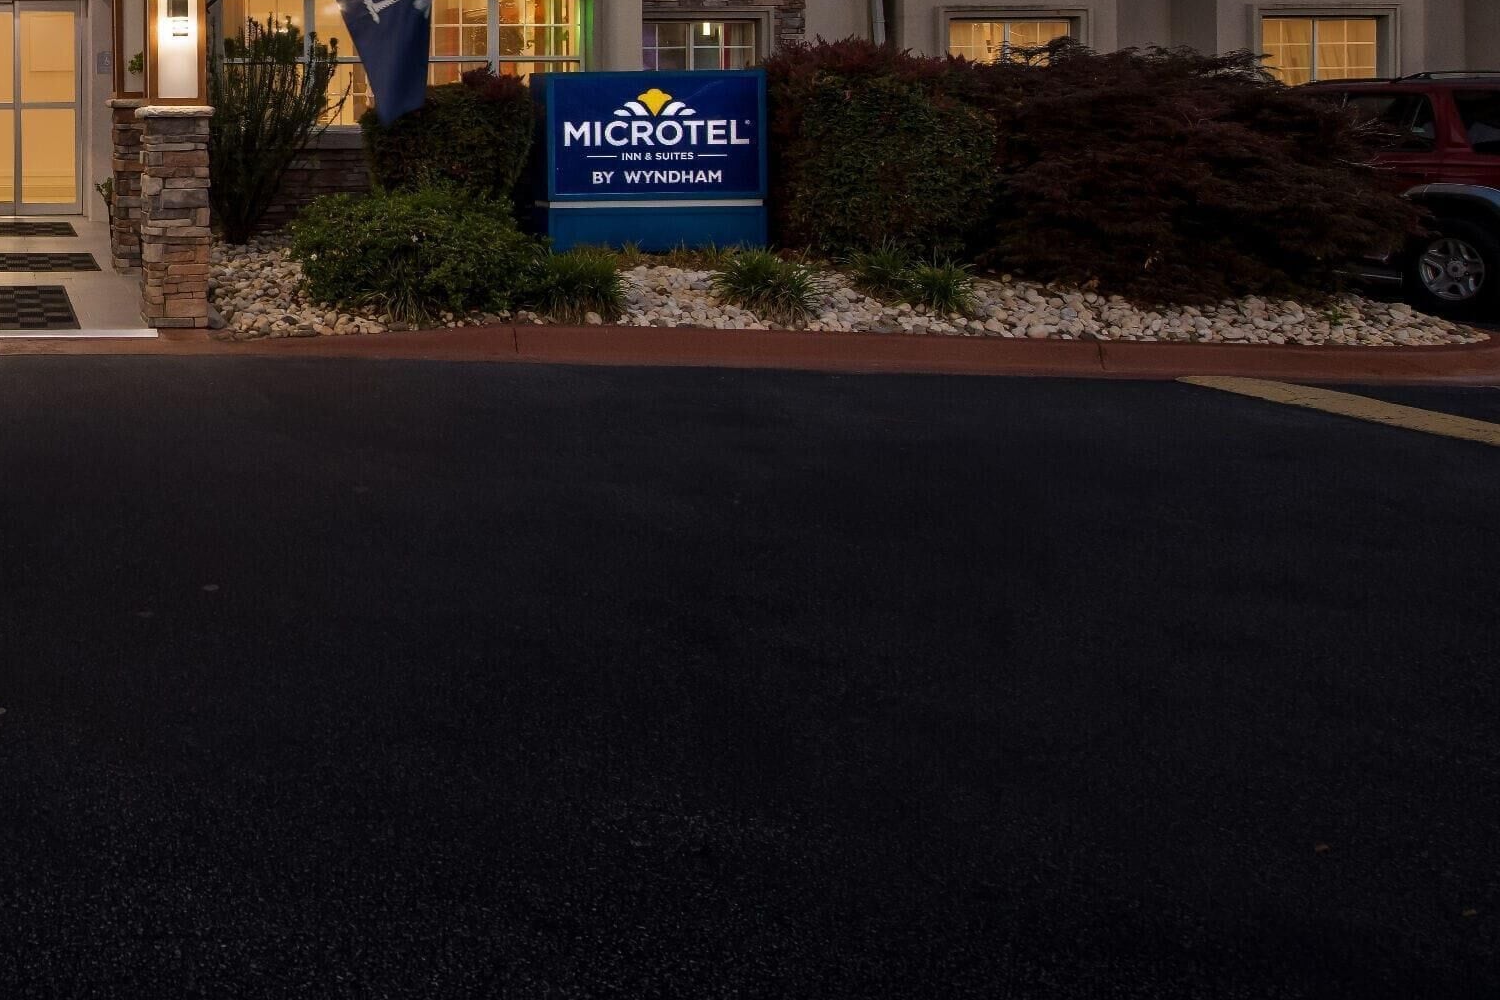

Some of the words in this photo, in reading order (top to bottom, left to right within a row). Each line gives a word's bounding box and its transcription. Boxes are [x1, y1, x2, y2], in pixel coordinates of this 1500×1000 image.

[563, 119, 750, 147] MICROTEL
[621, 152, 642, 161] INN
[644, 152, 653, 161] &
[655, 151, 694, 161] SUITES
[592, 170, 615, 184] BY
[624, 169, 722, 184] WYNDHAM
